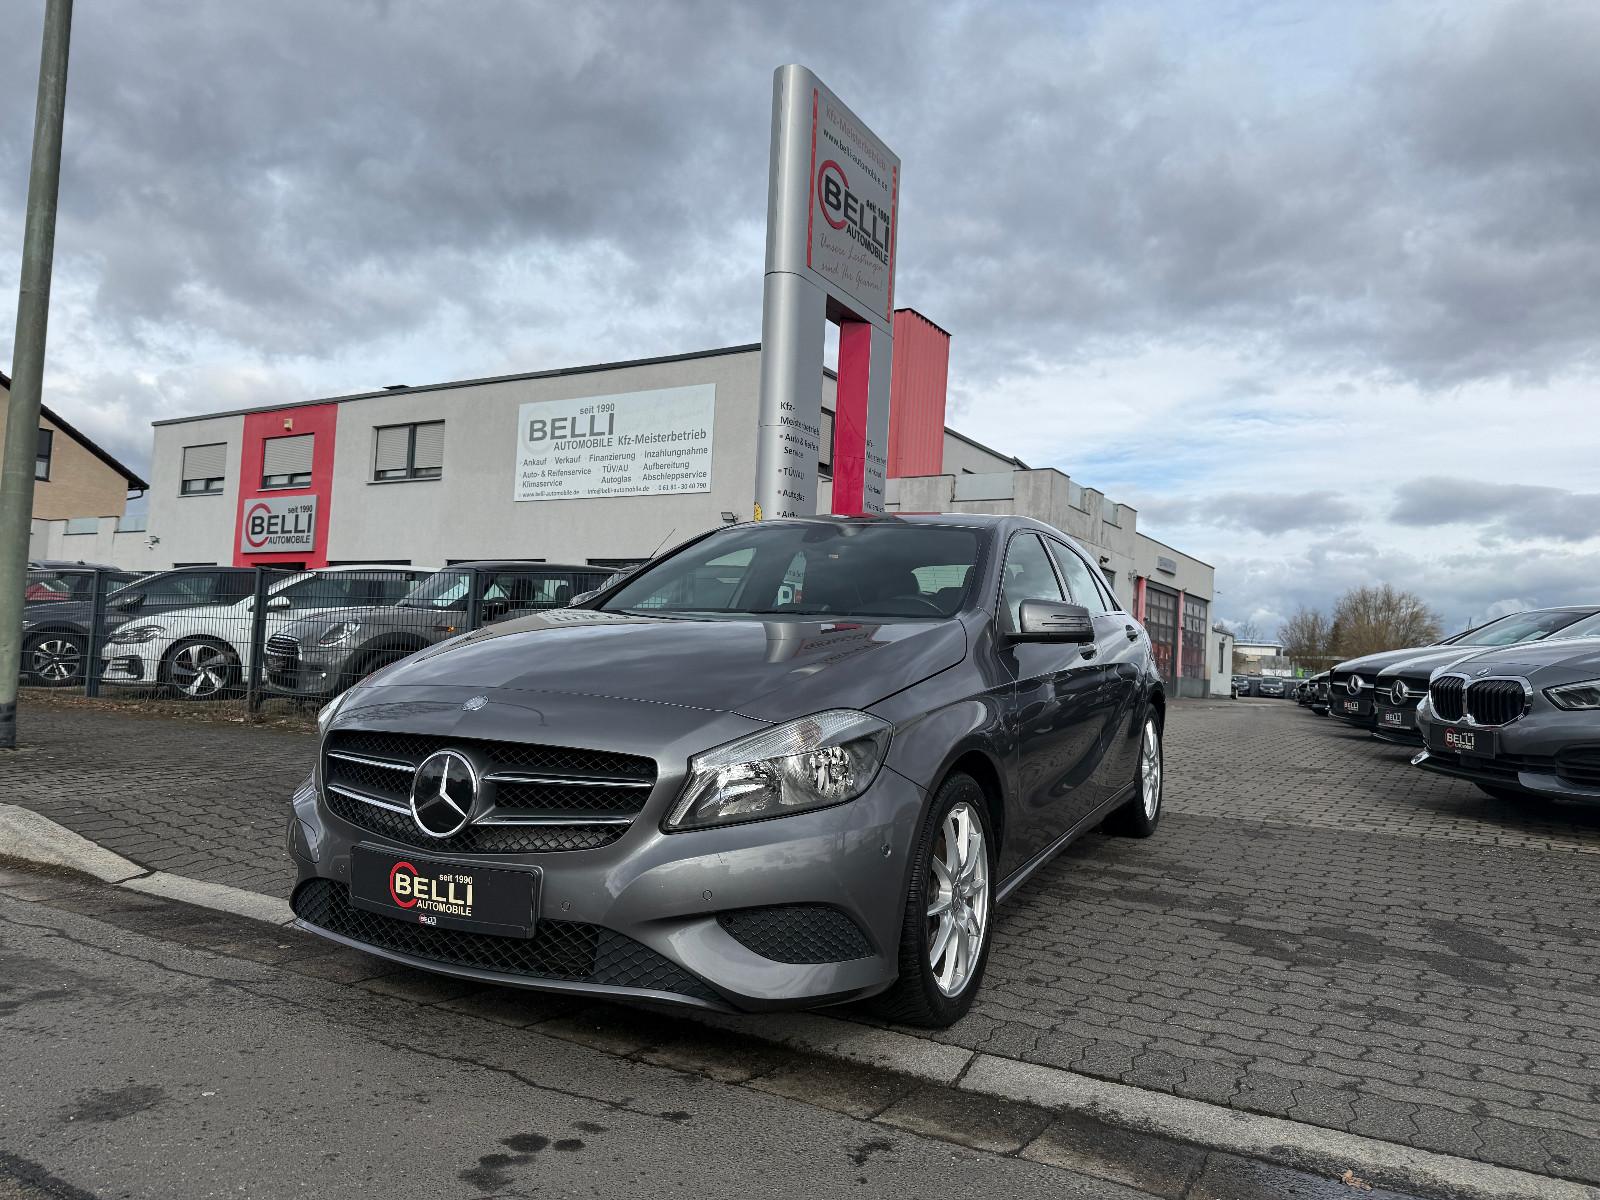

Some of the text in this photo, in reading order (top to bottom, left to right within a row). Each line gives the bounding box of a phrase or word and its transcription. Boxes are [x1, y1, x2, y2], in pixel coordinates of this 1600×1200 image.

[824, 175, 890, 252] BELLI
[846, 224, 888, 265] AUTOMOBILE
[580, 403, 615, 415] seit 1990
[780, 401, 795, 411] Kfz-
[528, 413, 615, 442] BELLI
[554, 429, 706, 451] AUTOMOBILE Kfz-Meisterbetrieb
[523, 447, 708, 467] Ankauf Verkauf Finanzierung Inzahlungnahme
[547, 467, 592, 478] Reifenservice
[602, 463, 629, 474] TÜV/AU
[643, 461, 690, 472] Aufbereitung
[522, 470, 707, 489] Klimaservice Autoglas Abschleppservice
[251, 514, 312, 535] BELLI
[268, 535, 310, 544] AUTOMOBILE
[1446, 733, 1474, 745] BELLI
[440, 874, 473, 884] seit 1990
[395, 873, 473, 906] BELLI
[417, 899, 472, 917] AUTOMOBILE
